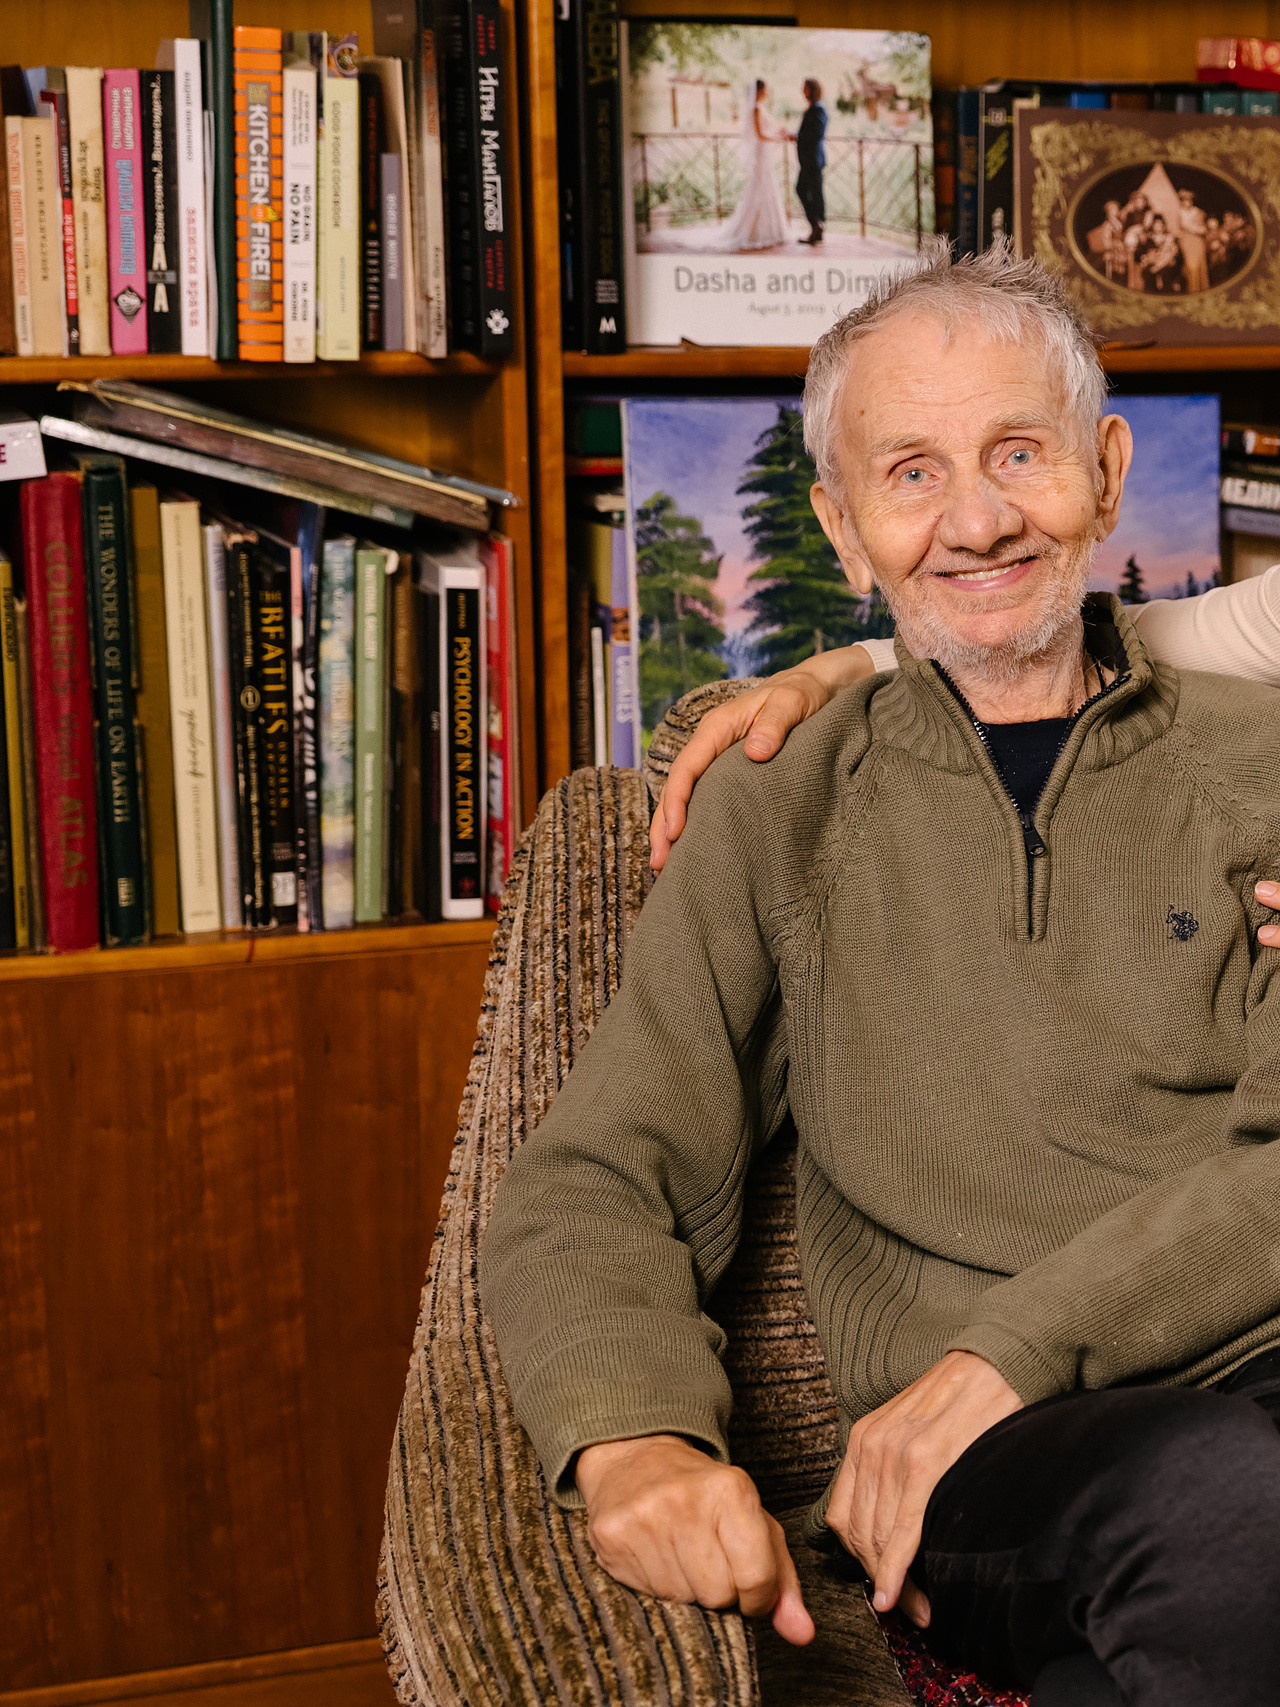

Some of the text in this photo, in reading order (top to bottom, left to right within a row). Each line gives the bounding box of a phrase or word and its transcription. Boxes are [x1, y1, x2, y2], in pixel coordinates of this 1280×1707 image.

[249, 104, 270, 204] KITCHEN
[290, 183, 301, 245] NO PAIN
[302, 184, 312, 242] NO GRAIN
[250, 222, 271, 281] FIRE!
[674, 266, 757, 294] Dasha
[766, 269, 815, 294] and
[98, 502, 131, 822] THE WONDERS OF LIFE ON EARTH
[453, 636, 472, 749] PSYCHOLOGY
[455, 753, 473, 771] IN
[454, 775, 474, 839] ACTION
[59, 795, 88, 888] ATLAS
